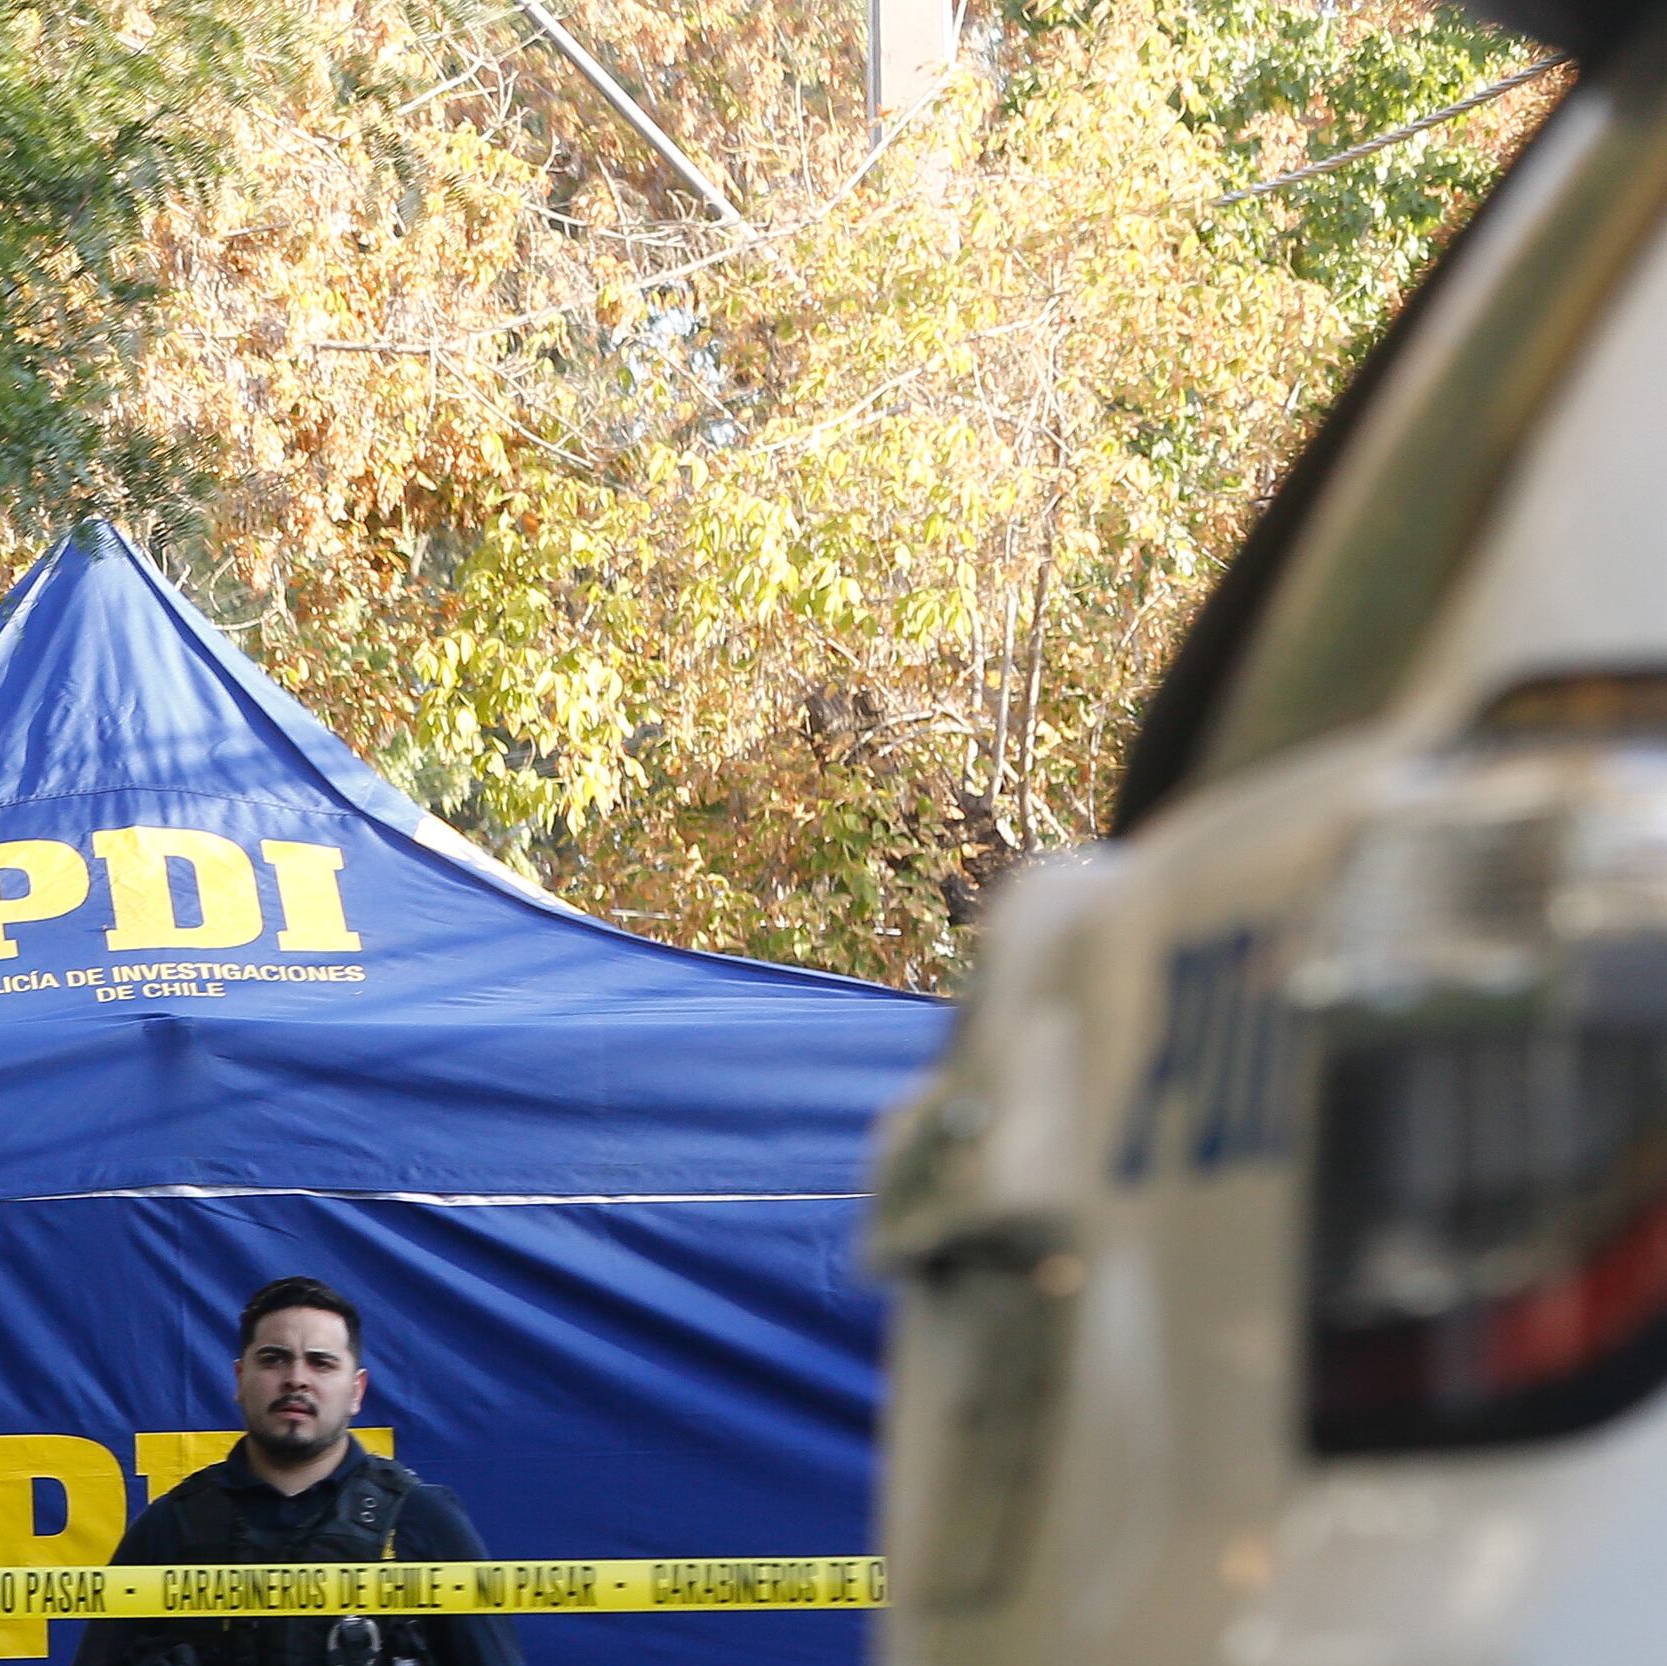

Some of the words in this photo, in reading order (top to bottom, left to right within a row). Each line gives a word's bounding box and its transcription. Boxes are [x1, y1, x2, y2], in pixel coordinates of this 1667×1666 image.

[67, 967, 106, 986] DE
[112, 963, 366, 984] INVESTIGACIONES
[96, 982, 140, 1004] DE
[142, 980, 226, 1000] CHILE
[24, 1571, 107, 1614] PASAR
[162, 1568, 327, 1612] CARABINEROS
[337, 1567, 369, 1611] DE
[376, 1566, 444, 1610] CHILE
[474, 1566, 506, 1609] NO
[514, 1565, 597, 1608] PASAR
[652, 1562, 817, 1605] CARABINEROS
[827, 1561, 859, 1604] DE
